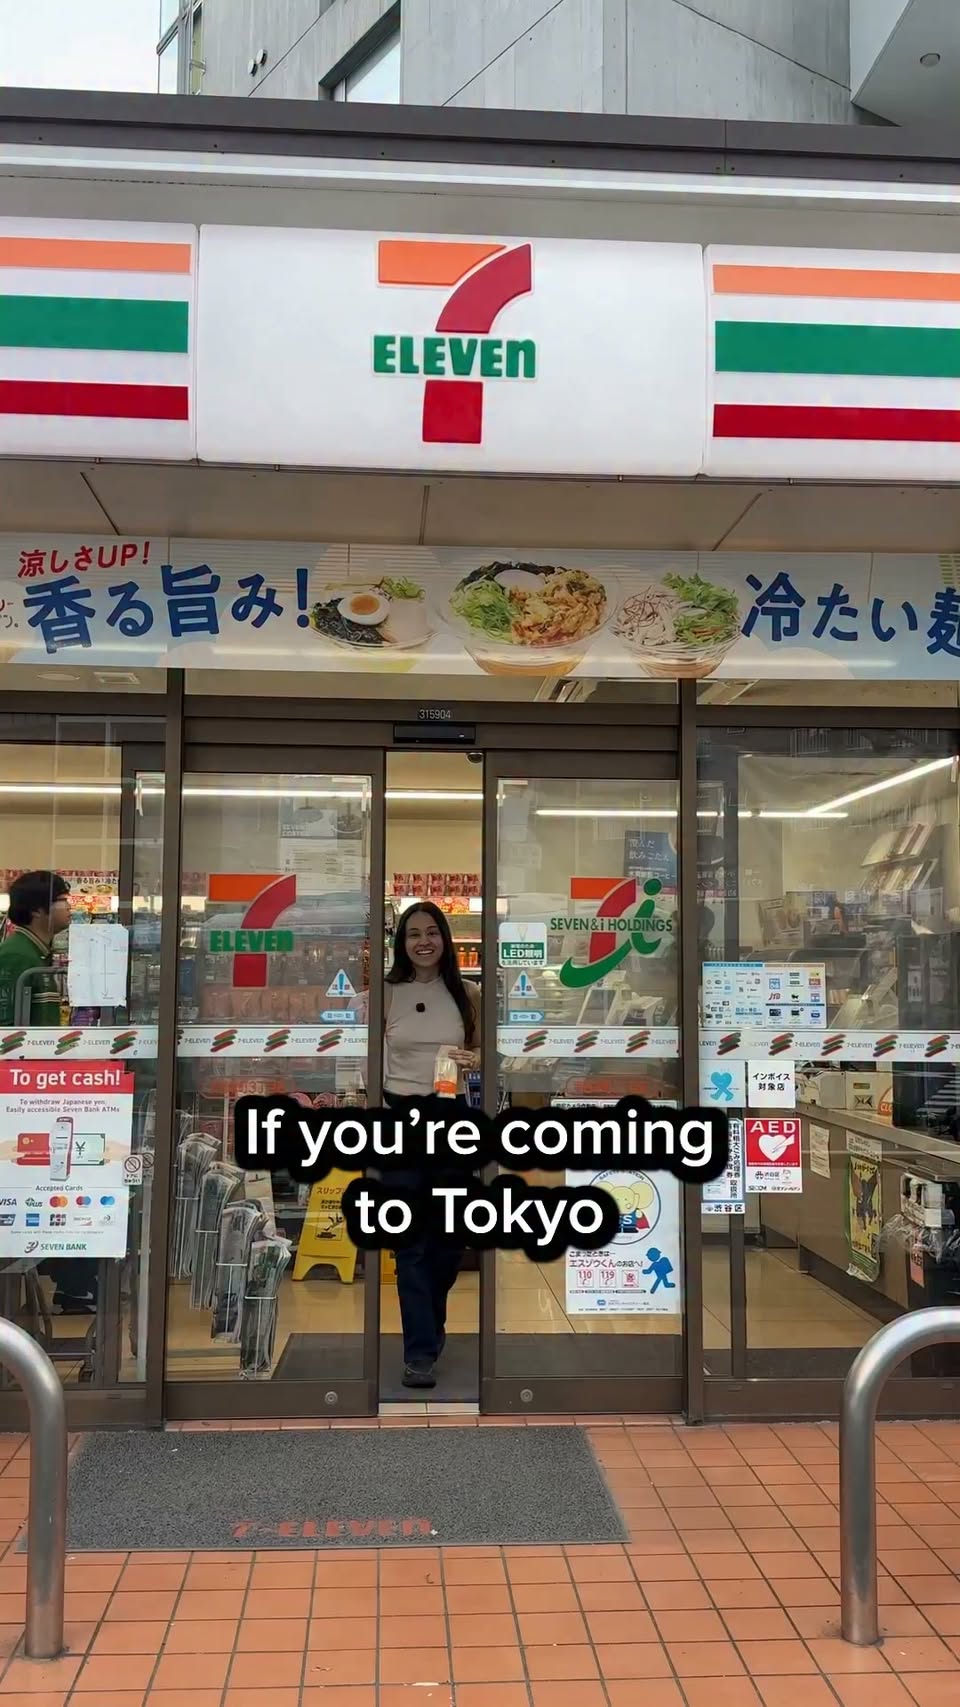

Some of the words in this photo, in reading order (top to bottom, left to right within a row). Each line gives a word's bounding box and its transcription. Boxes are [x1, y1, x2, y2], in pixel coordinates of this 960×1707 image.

[378, 240, 533, 444] 7
[17, 541, 150, 578] 涼しさUP!
[23, 564, 310, 654] 香る旨み!
[419, 709, 451, 719] 315904
[608, 919, 673, 932] HOLDINGS
[10, 1069, 31, 1086] To
[36, 1070, 67, 1089] get
[72, 1069, 120, 1086] cash!
[752, 1073, 791, 1081] インボイス
[758, 1082, 785, 1091] 対象店
[750, 1120, 796, 1133] AED
[36, 1184, 64, 1192] Accepted
[65, 1184, 83, 1192] Cards
[578, 1270, 592, 1279] 110
[601, 1270, 615, 1279] 119
